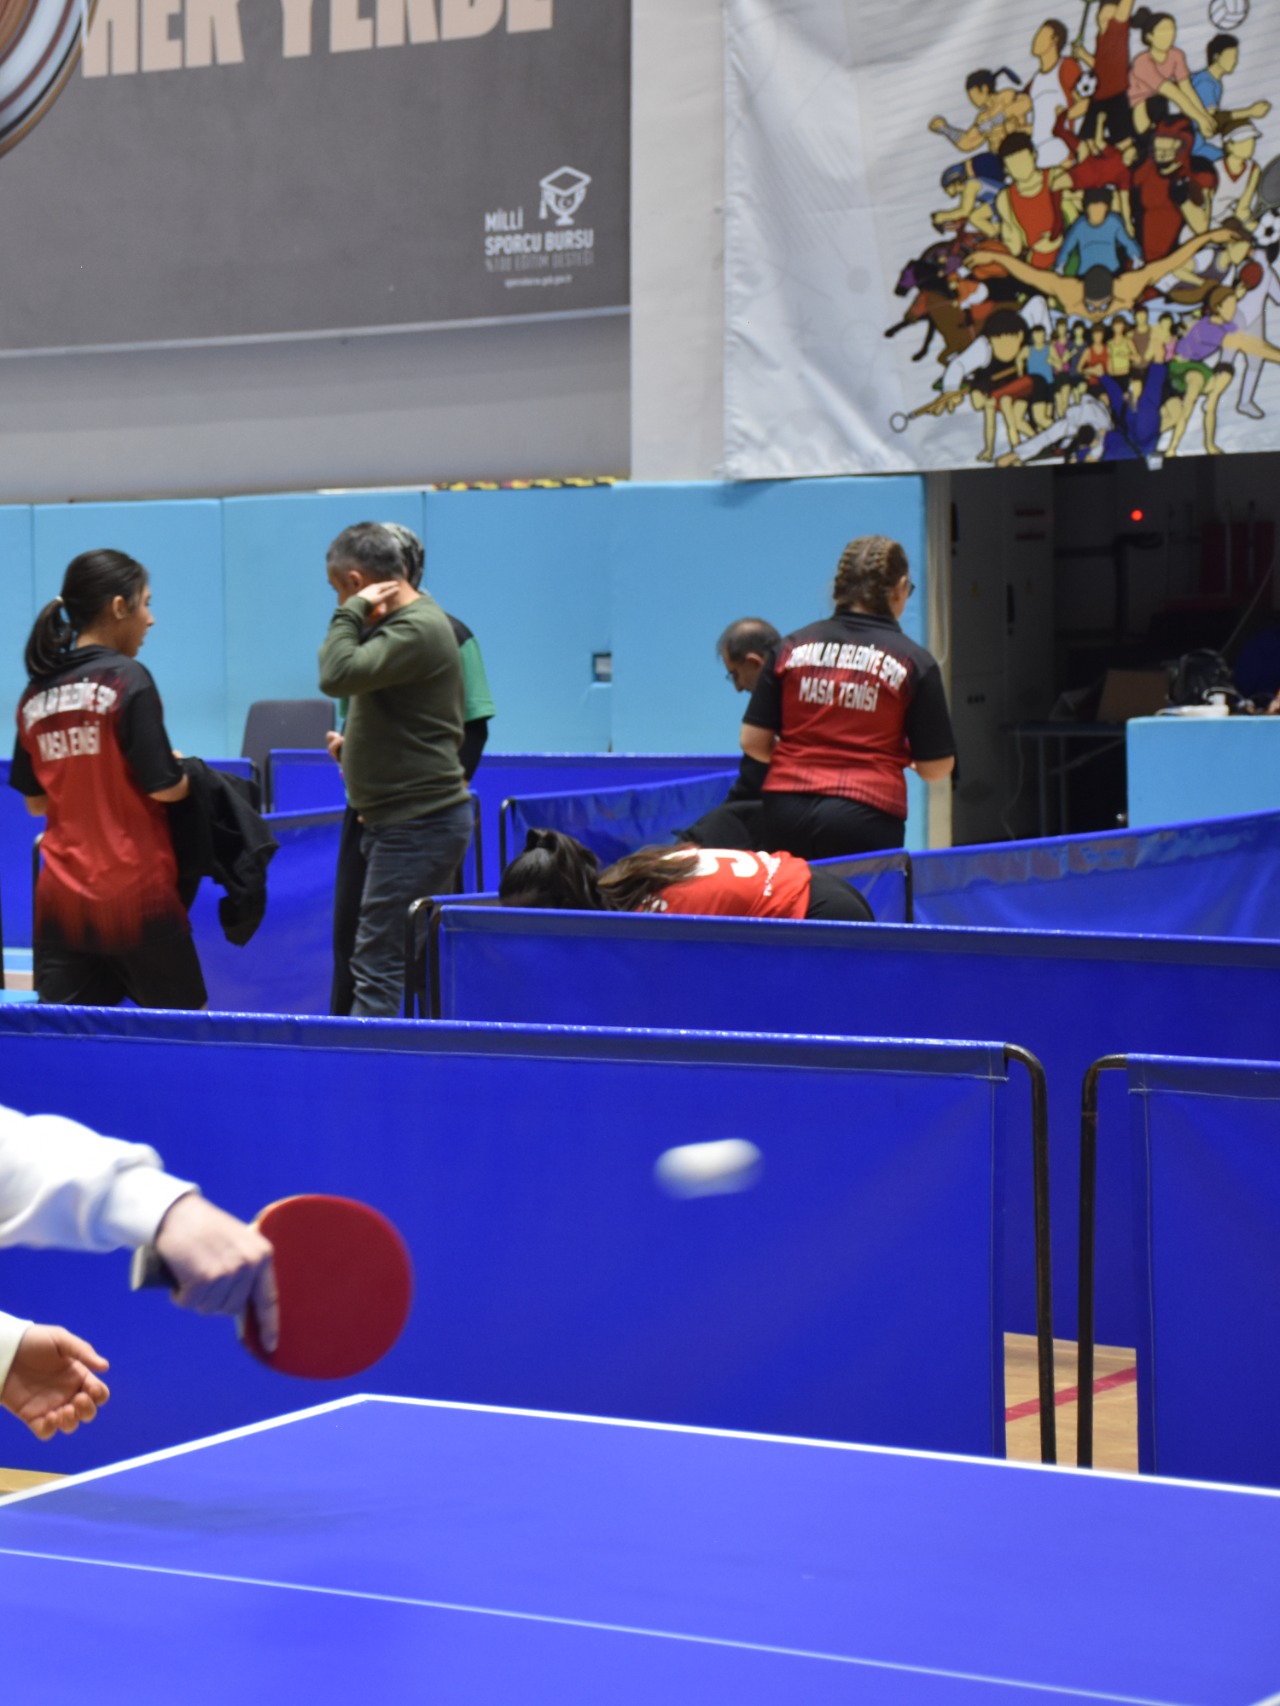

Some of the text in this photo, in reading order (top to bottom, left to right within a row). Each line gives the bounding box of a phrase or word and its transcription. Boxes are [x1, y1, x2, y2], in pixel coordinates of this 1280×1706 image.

[484, 228, 594, 256] SPORCU BURSU
[798, 676, 880, 712] MASA TENİSİ
